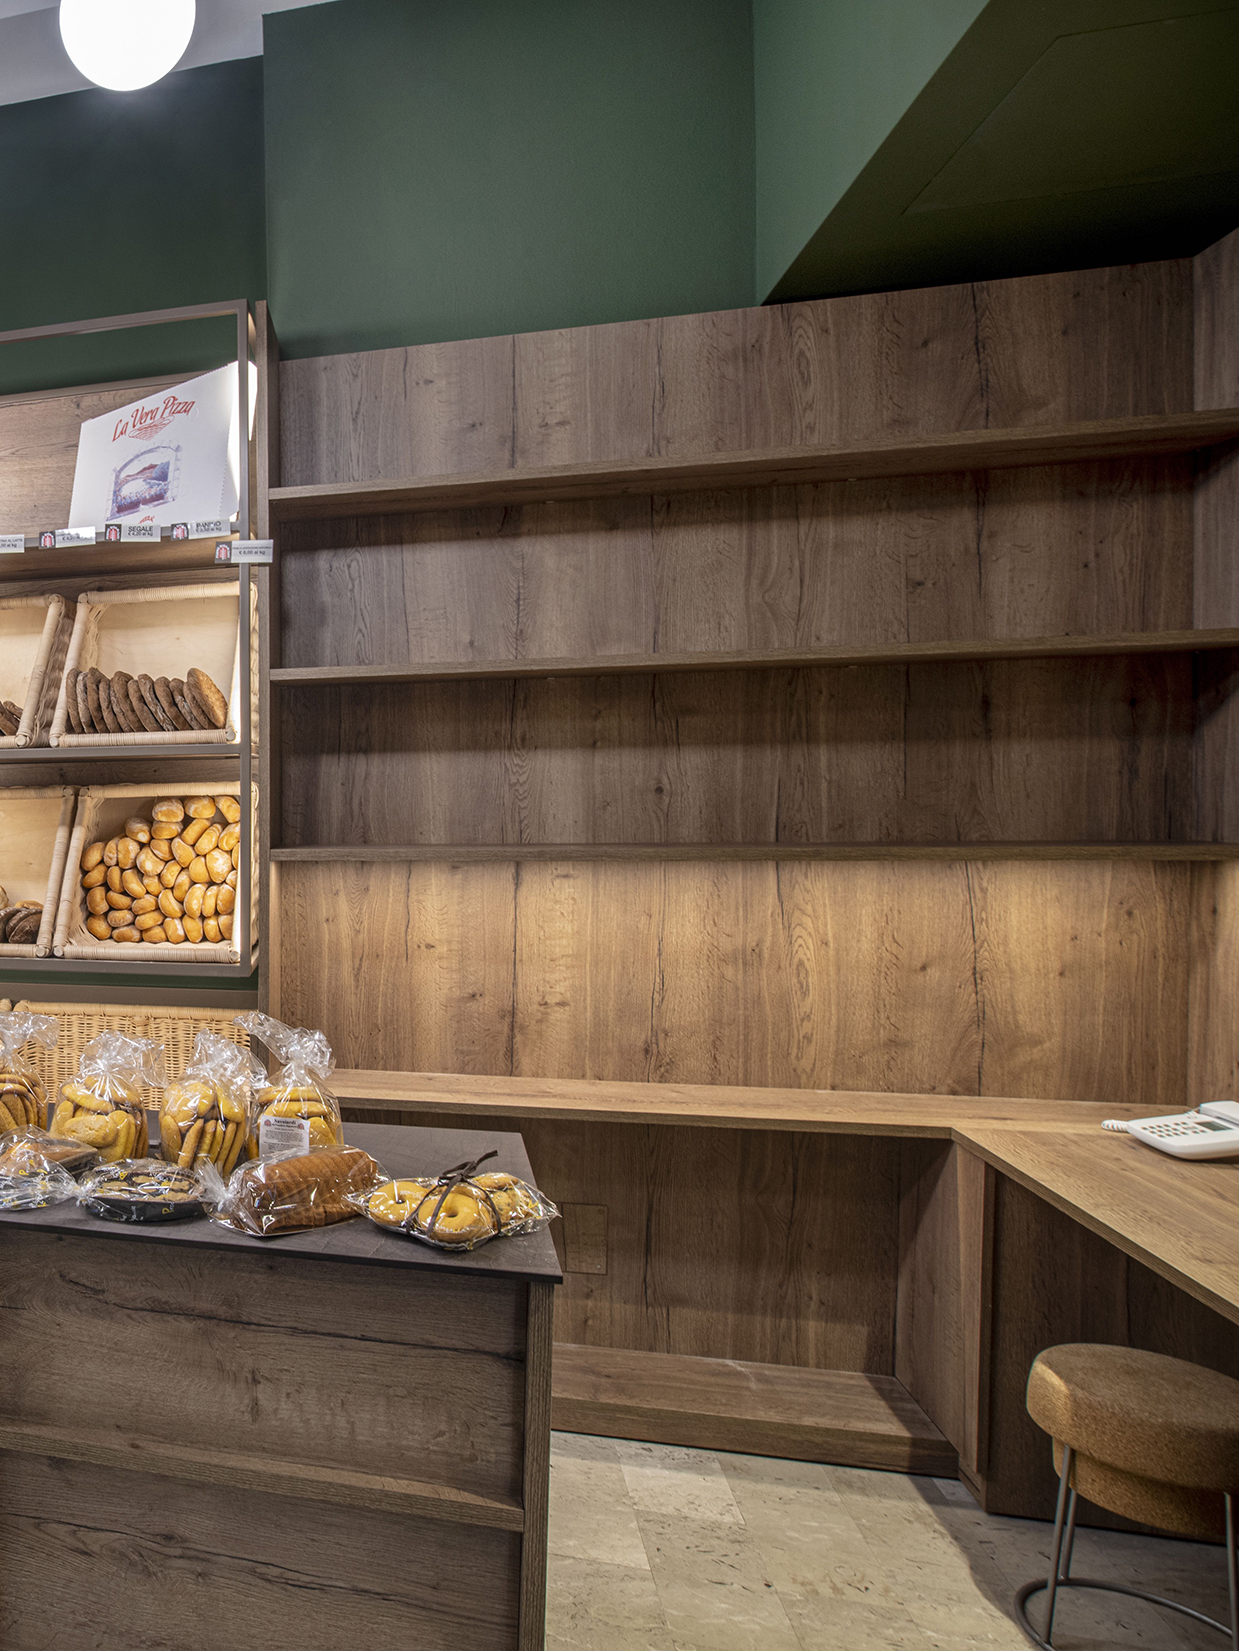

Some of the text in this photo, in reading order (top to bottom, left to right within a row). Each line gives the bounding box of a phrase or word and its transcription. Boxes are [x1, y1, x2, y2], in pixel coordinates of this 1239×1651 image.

[112, 395, 195, 442] La Vera Pizza
